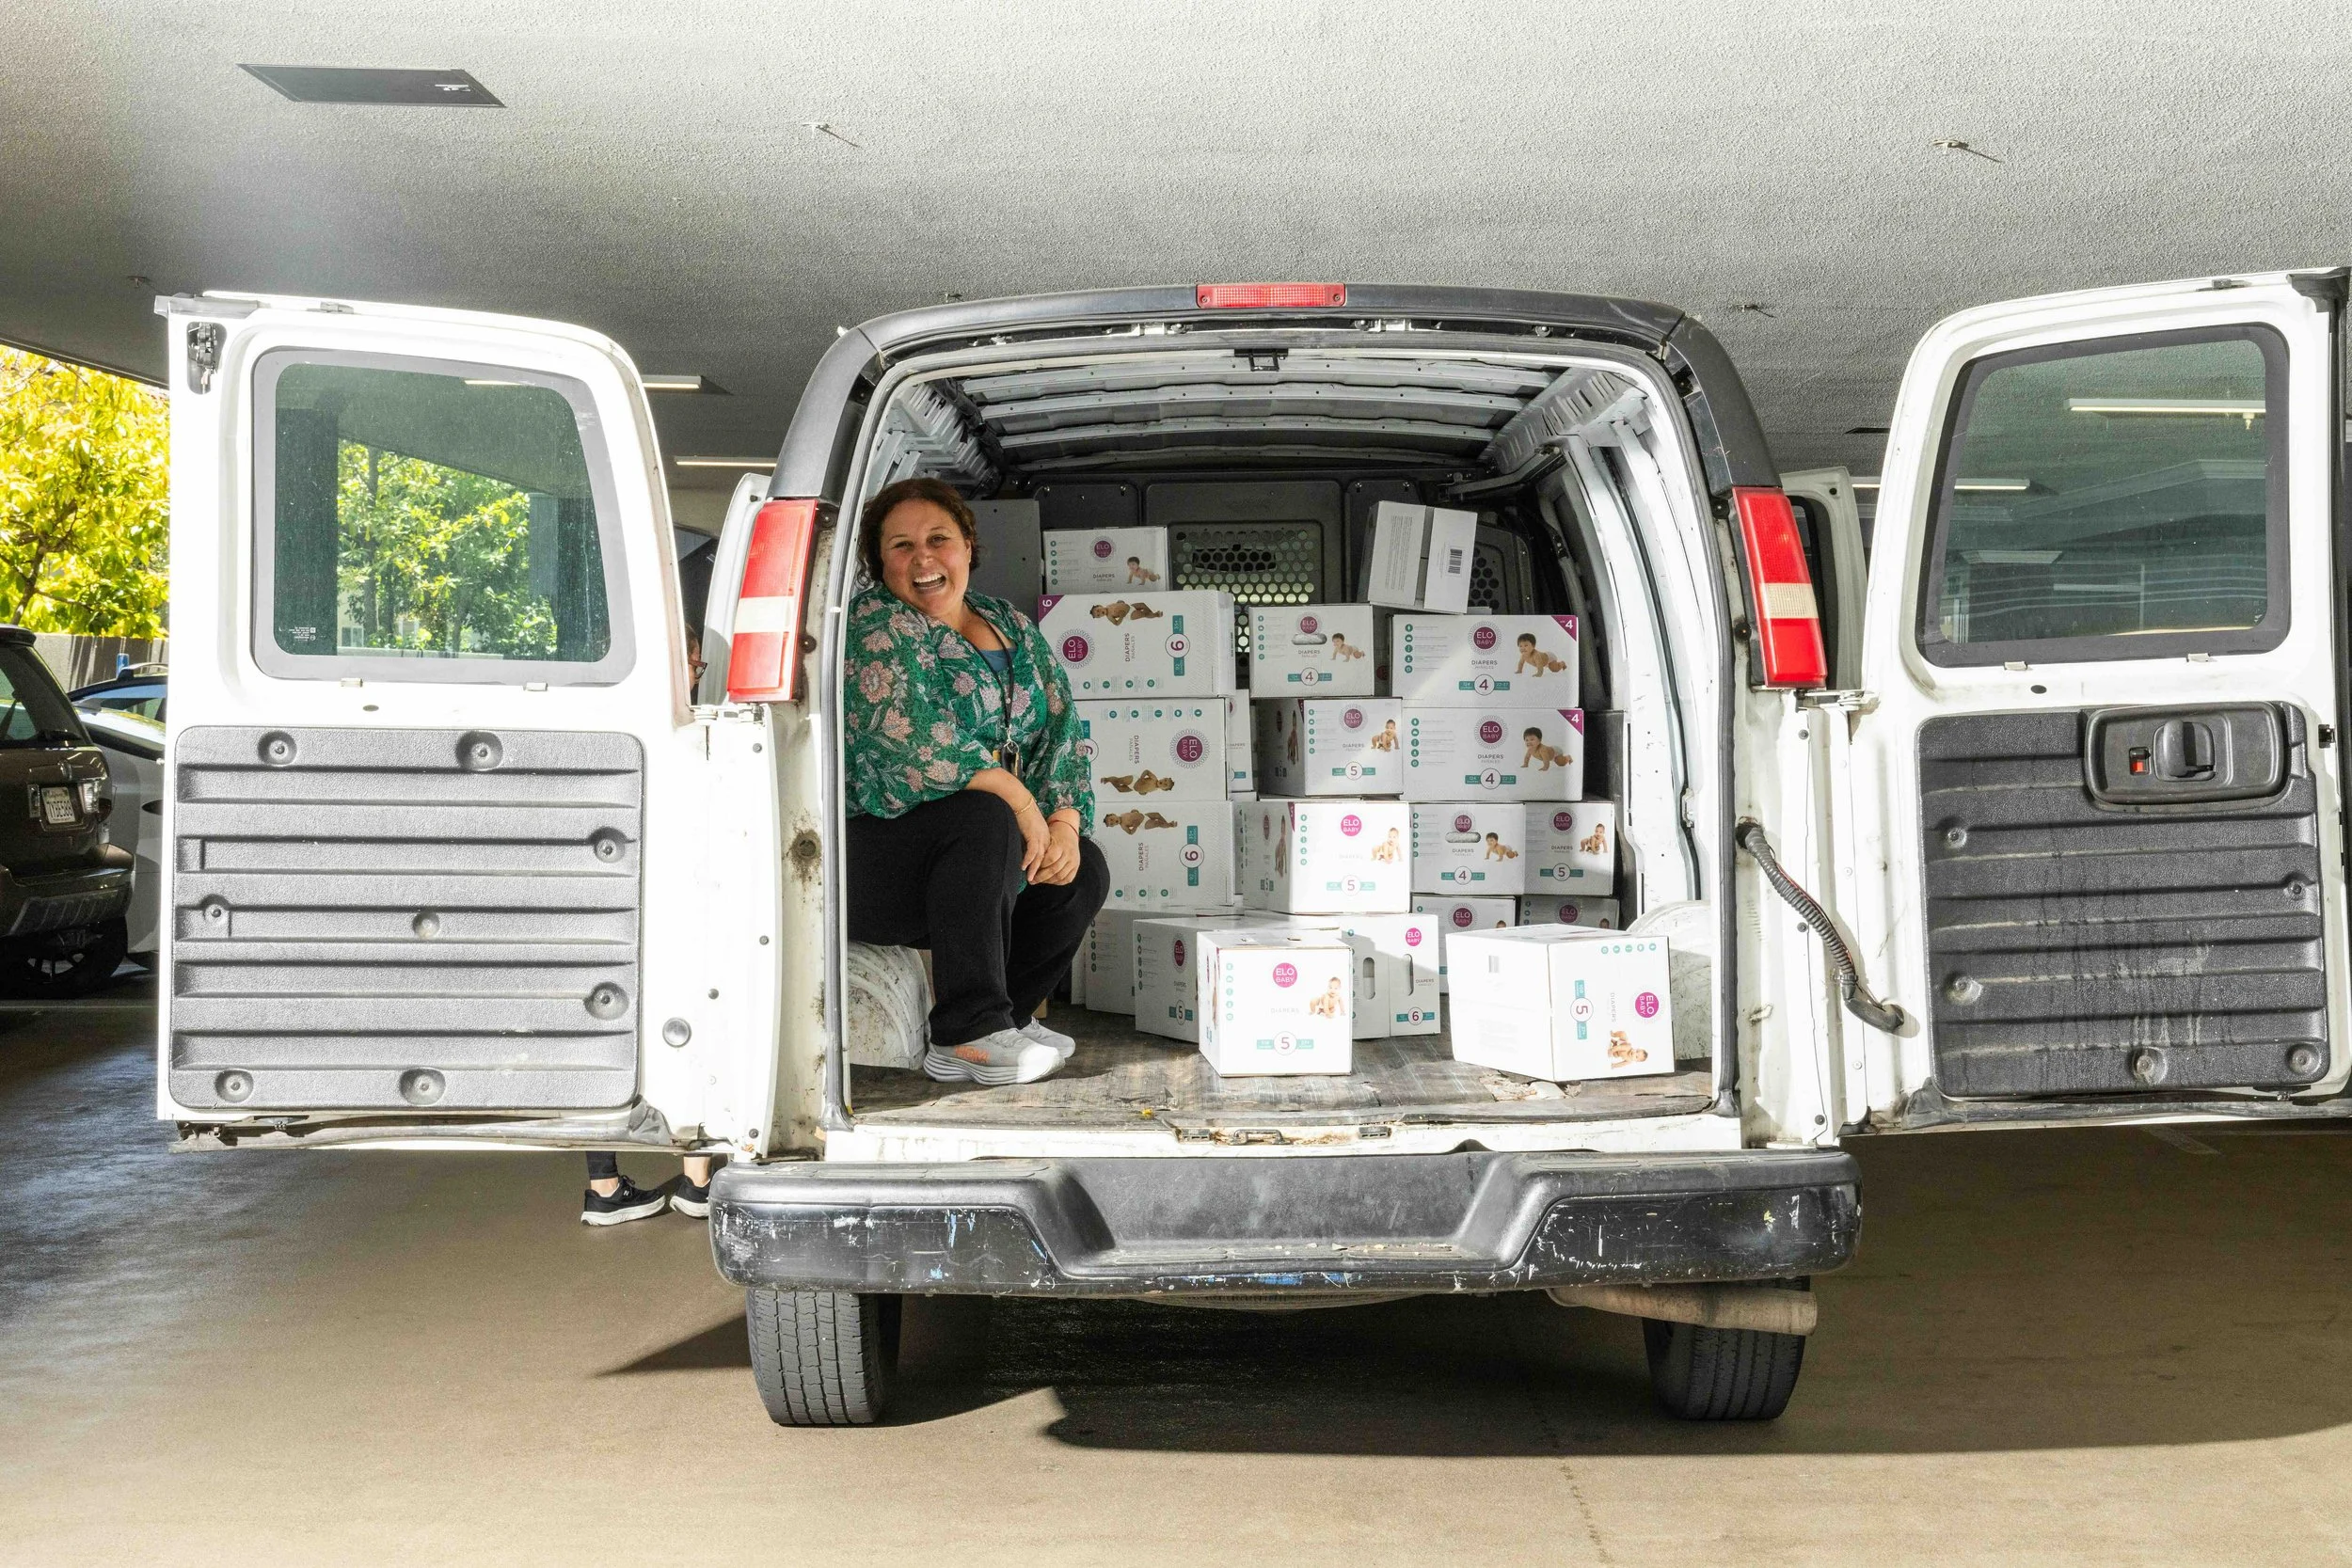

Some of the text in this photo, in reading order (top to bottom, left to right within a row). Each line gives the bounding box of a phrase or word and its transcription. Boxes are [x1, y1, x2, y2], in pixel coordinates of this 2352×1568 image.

[1565, 620, 1573, 629] 4
[1170, 641, 1184, 651] 6
[1305, 672, 1313, 681] 4
[1479, 678, 1488, 690] 4
[1571, 714, 1580, 723] 4
[1189, 739, 1198, 758] ELO
[1350, 766, 1358, 776] 5
[1486, 772, 1495, 784] 4
[1184, 850, 1199, 862] 6
[1458, 870, 1467, 880] 4
[1558, 867, 1565, 877] 5
[1347, 879, 1355, 891] 5
[1276, 968, 1295, 976] ELO
[1178, 1006, 1183, 1019] 5
[1576, 1006, 1588, 1015] 5
[1412, 1011, 1419, 1022] 6
[1280, 1037, 1290, 1050] 5
